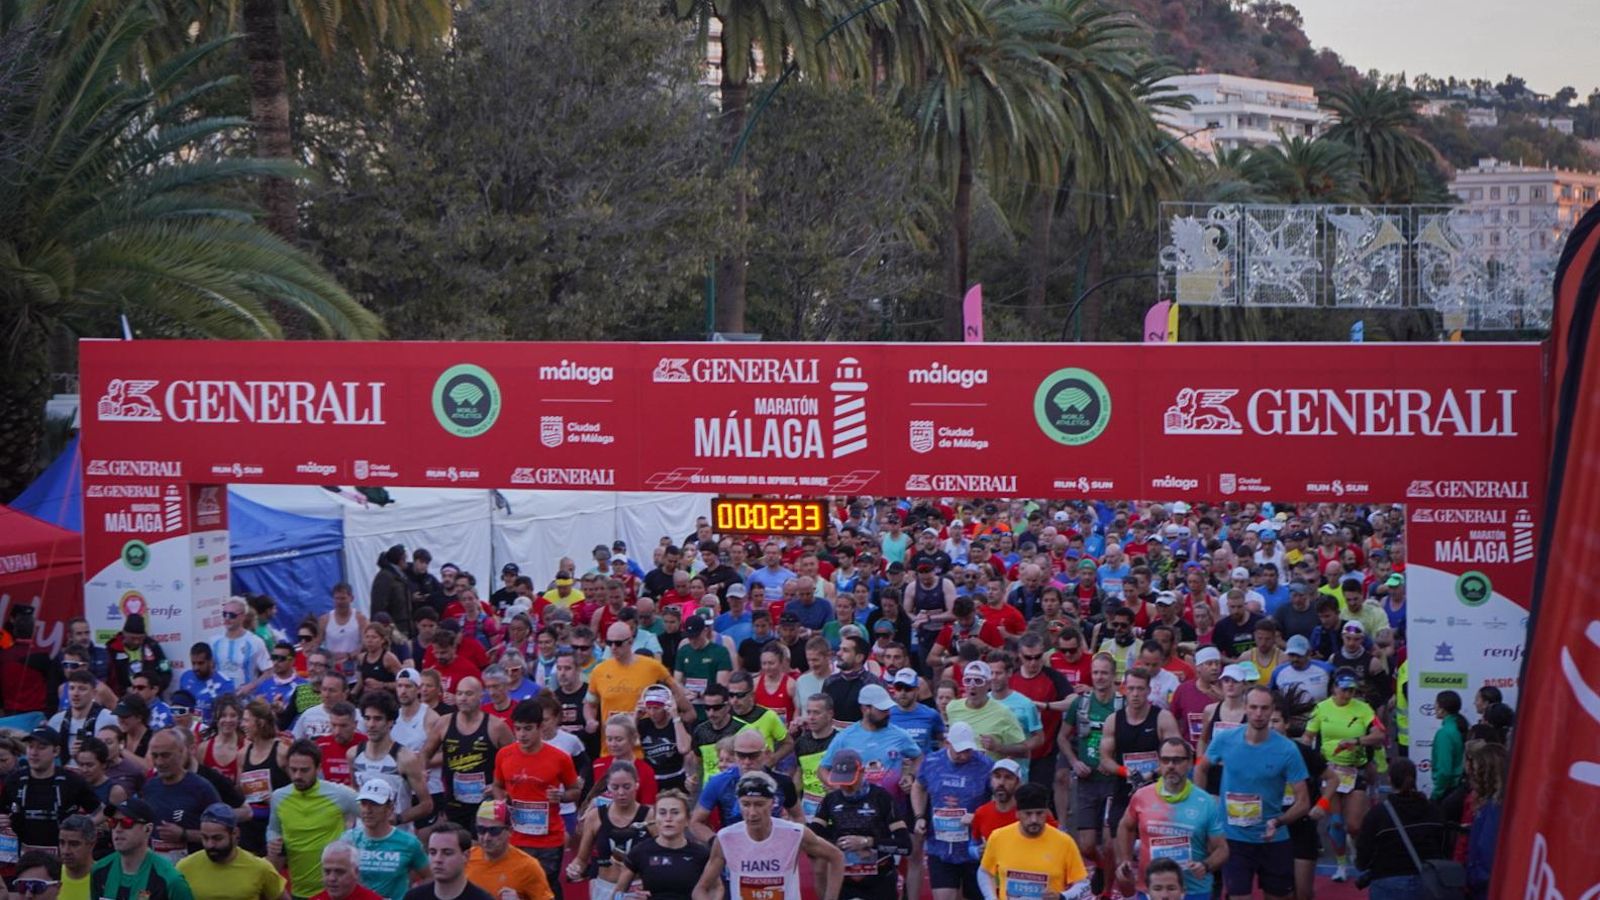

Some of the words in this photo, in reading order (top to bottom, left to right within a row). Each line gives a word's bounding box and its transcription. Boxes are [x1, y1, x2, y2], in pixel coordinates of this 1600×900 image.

[691, 358, 820, 384] GENERALI
[164, 380, 386, 425] GENERALI
[754, 394, 819, 416] MARATÓN
[1246, 388, 1518, 437] GENERALI
[566, 422, 601, 433] Ciudad
[694, 409, 825, 459] MÁLAGA
[937, 426, 975, 437] Ciudad
[567, 434, 582, 443] de
[582, 433, 615, 446] Málaga
[938, 438, 953, 448] de
[953, 437, 990, 451] Málaga
[107, 460, 182, 477] GENERALI
[533, 467, 615, 486] GENERALI
[102, 485, 161, 498] GENERALI
[930, 474, 1017, 493] GENERALI
[1053, 480, 1077, 489] RUN
[1077, 476, 1091, 493] &
[1091, 480, 1114, 490] SUN
[1305, 483, 1331, 492] RUN
[1330, 479, 1345, 496] &
[1344, 483, 1370, 492] SUN
[1432, 480, 1529, 499] GENERALI
[104, 506, 164, 533] MÁLAGA
[717, 502, 821, 532] 00:02:33
[1432, 508, 1507, 524] GENERALI
[1435, 533, 1510, 564] MÁLAGA
[1425, 676, 1463, 685] GOLDCAR
[740, 858, 781, 872] HANS
[751, 889, 774, 900] 1679
